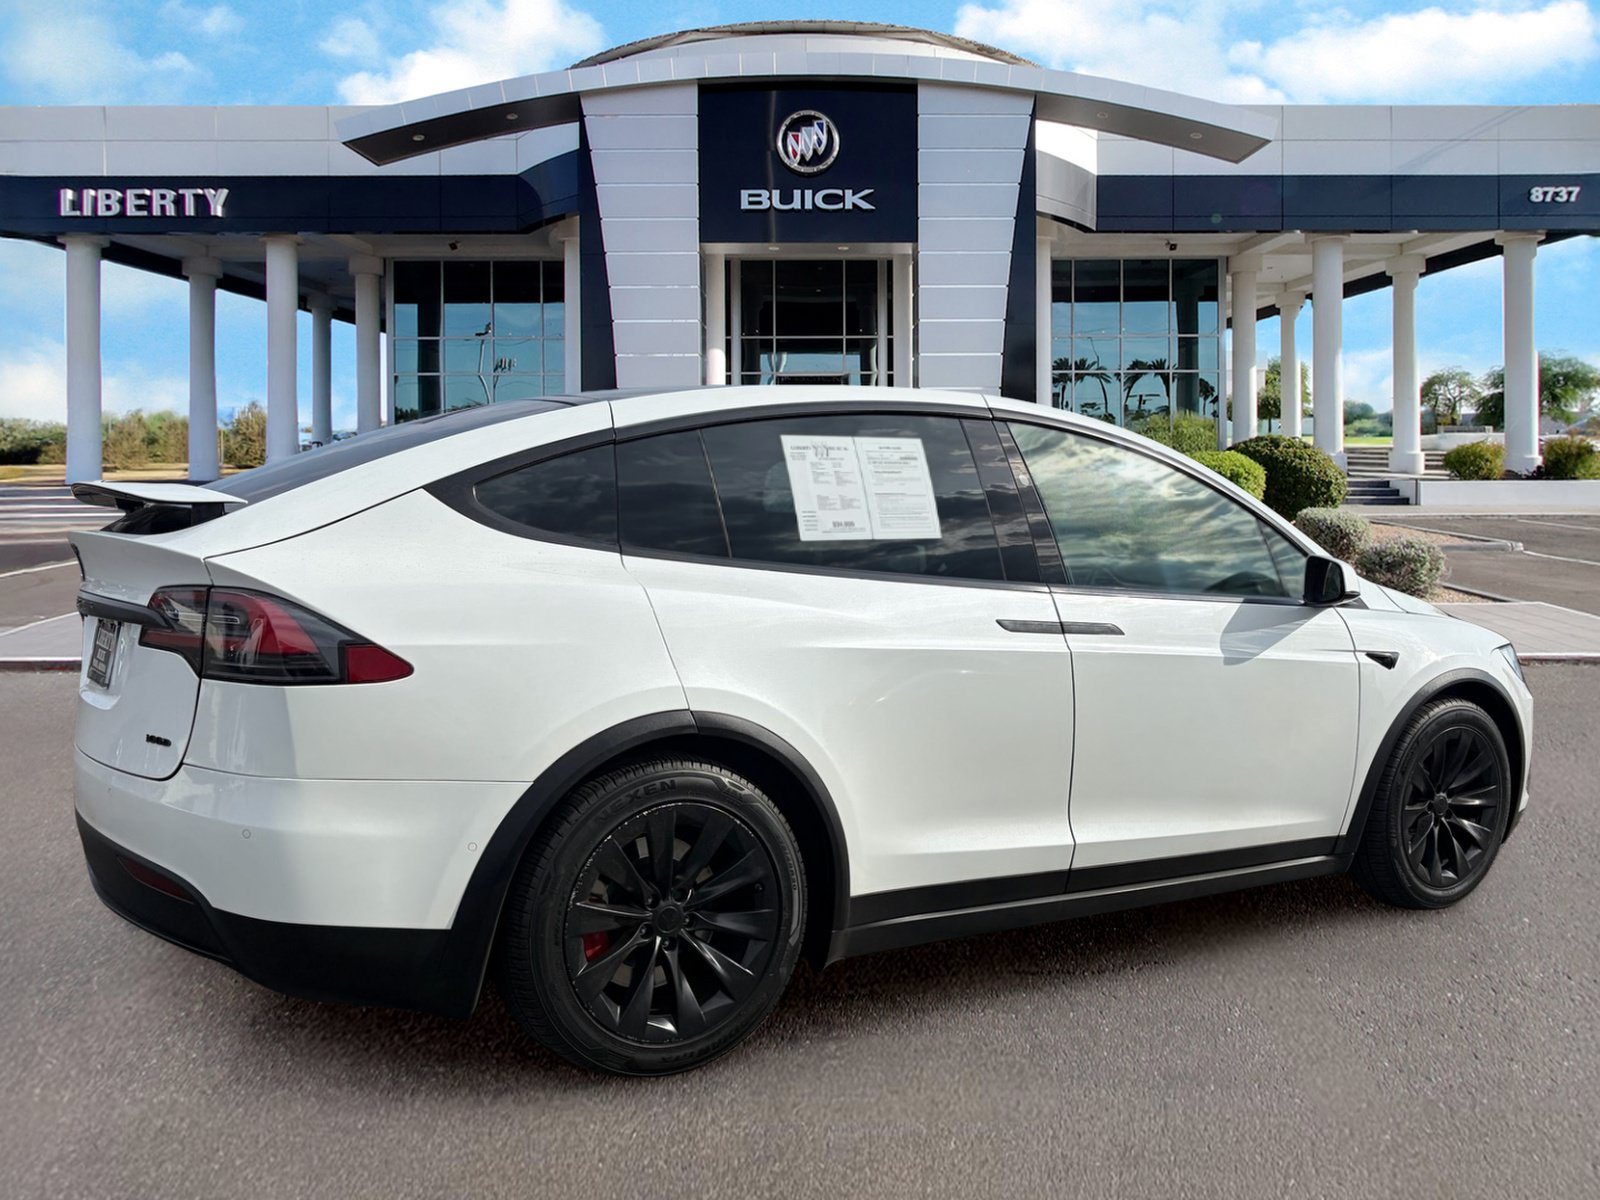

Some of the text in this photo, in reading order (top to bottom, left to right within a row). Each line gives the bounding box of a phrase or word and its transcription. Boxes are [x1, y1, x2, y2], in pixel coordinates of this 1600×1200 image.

[59, 188, 229, 217] LIBERTY
[740, 189, 876, 210] BUICK
[1529, 186, 1581, 203] 8737
[595, 779, 677, 822] NEXEN
